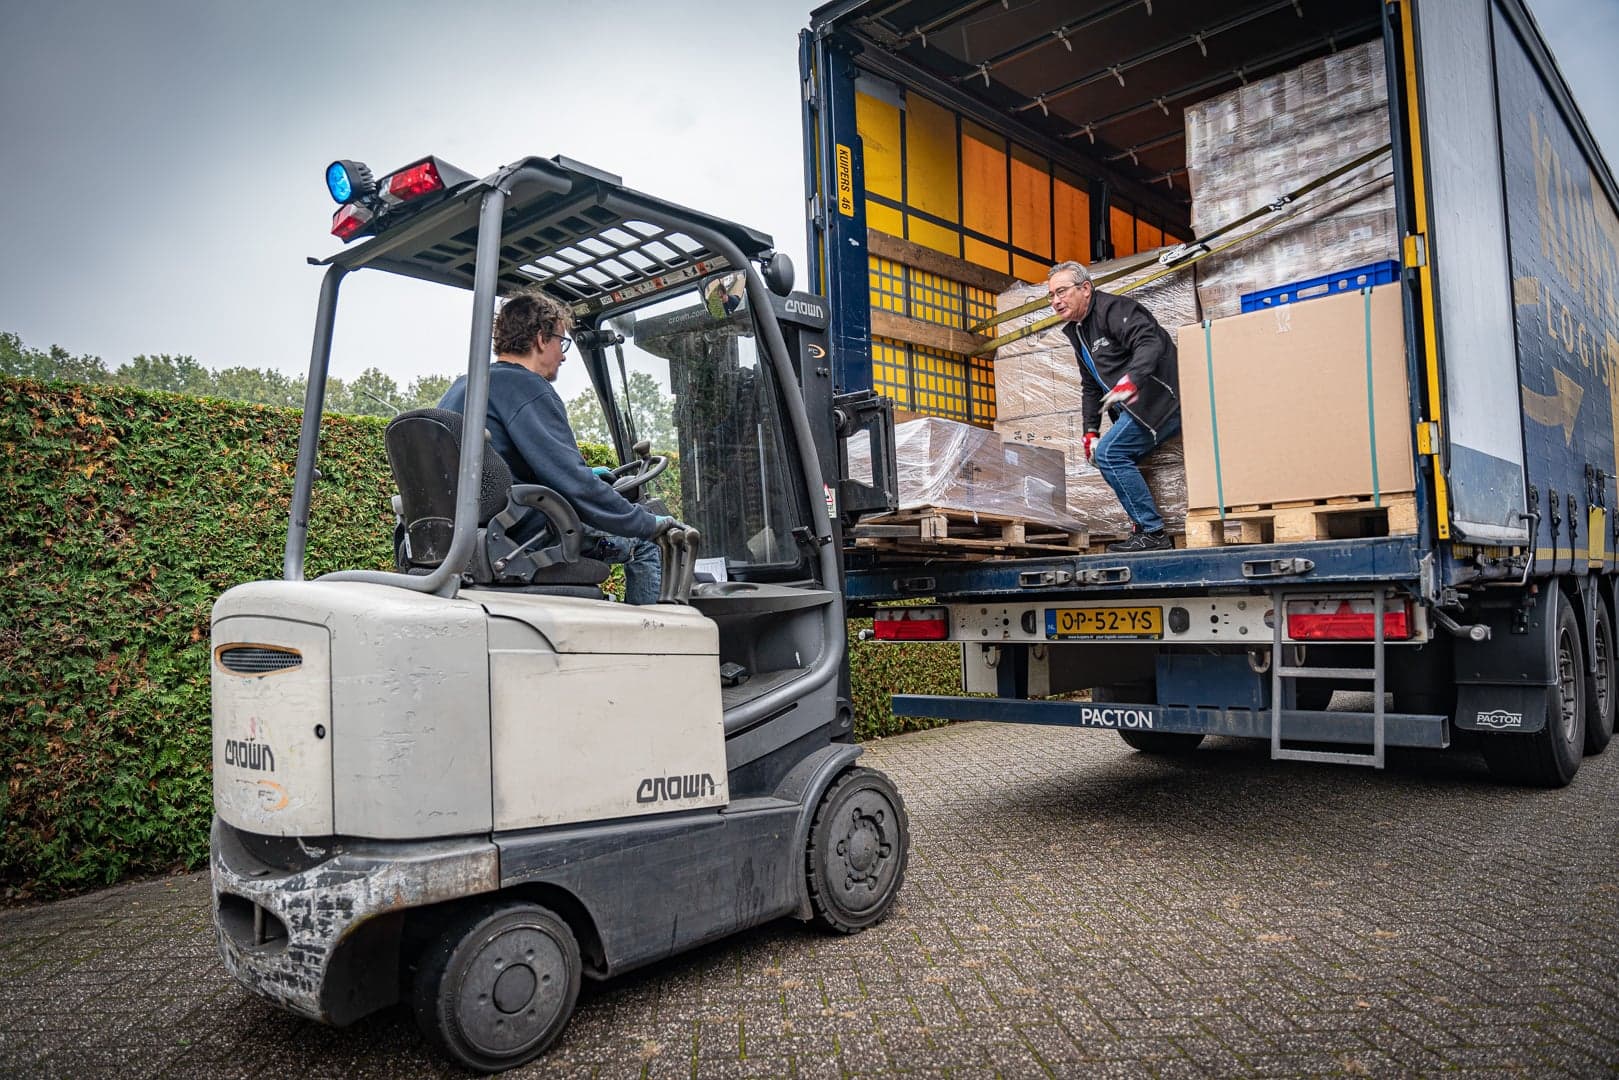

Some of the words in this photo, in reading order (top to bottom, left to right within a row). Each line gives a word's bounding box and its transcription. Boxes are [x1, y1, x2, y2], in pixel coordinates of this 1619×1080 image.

[839, 149, 850, 193] KUIPERS
[842, 197, 851, 210] 46
[1062, 611, 1152, 631] OP-52-YS
[1081, 708, 1153, 729] PACTON
[1476, 714, 1522, 724] PACTON
[225, 739, 275, 773] CROWN
[636, 773, 715, 804] CROWN
